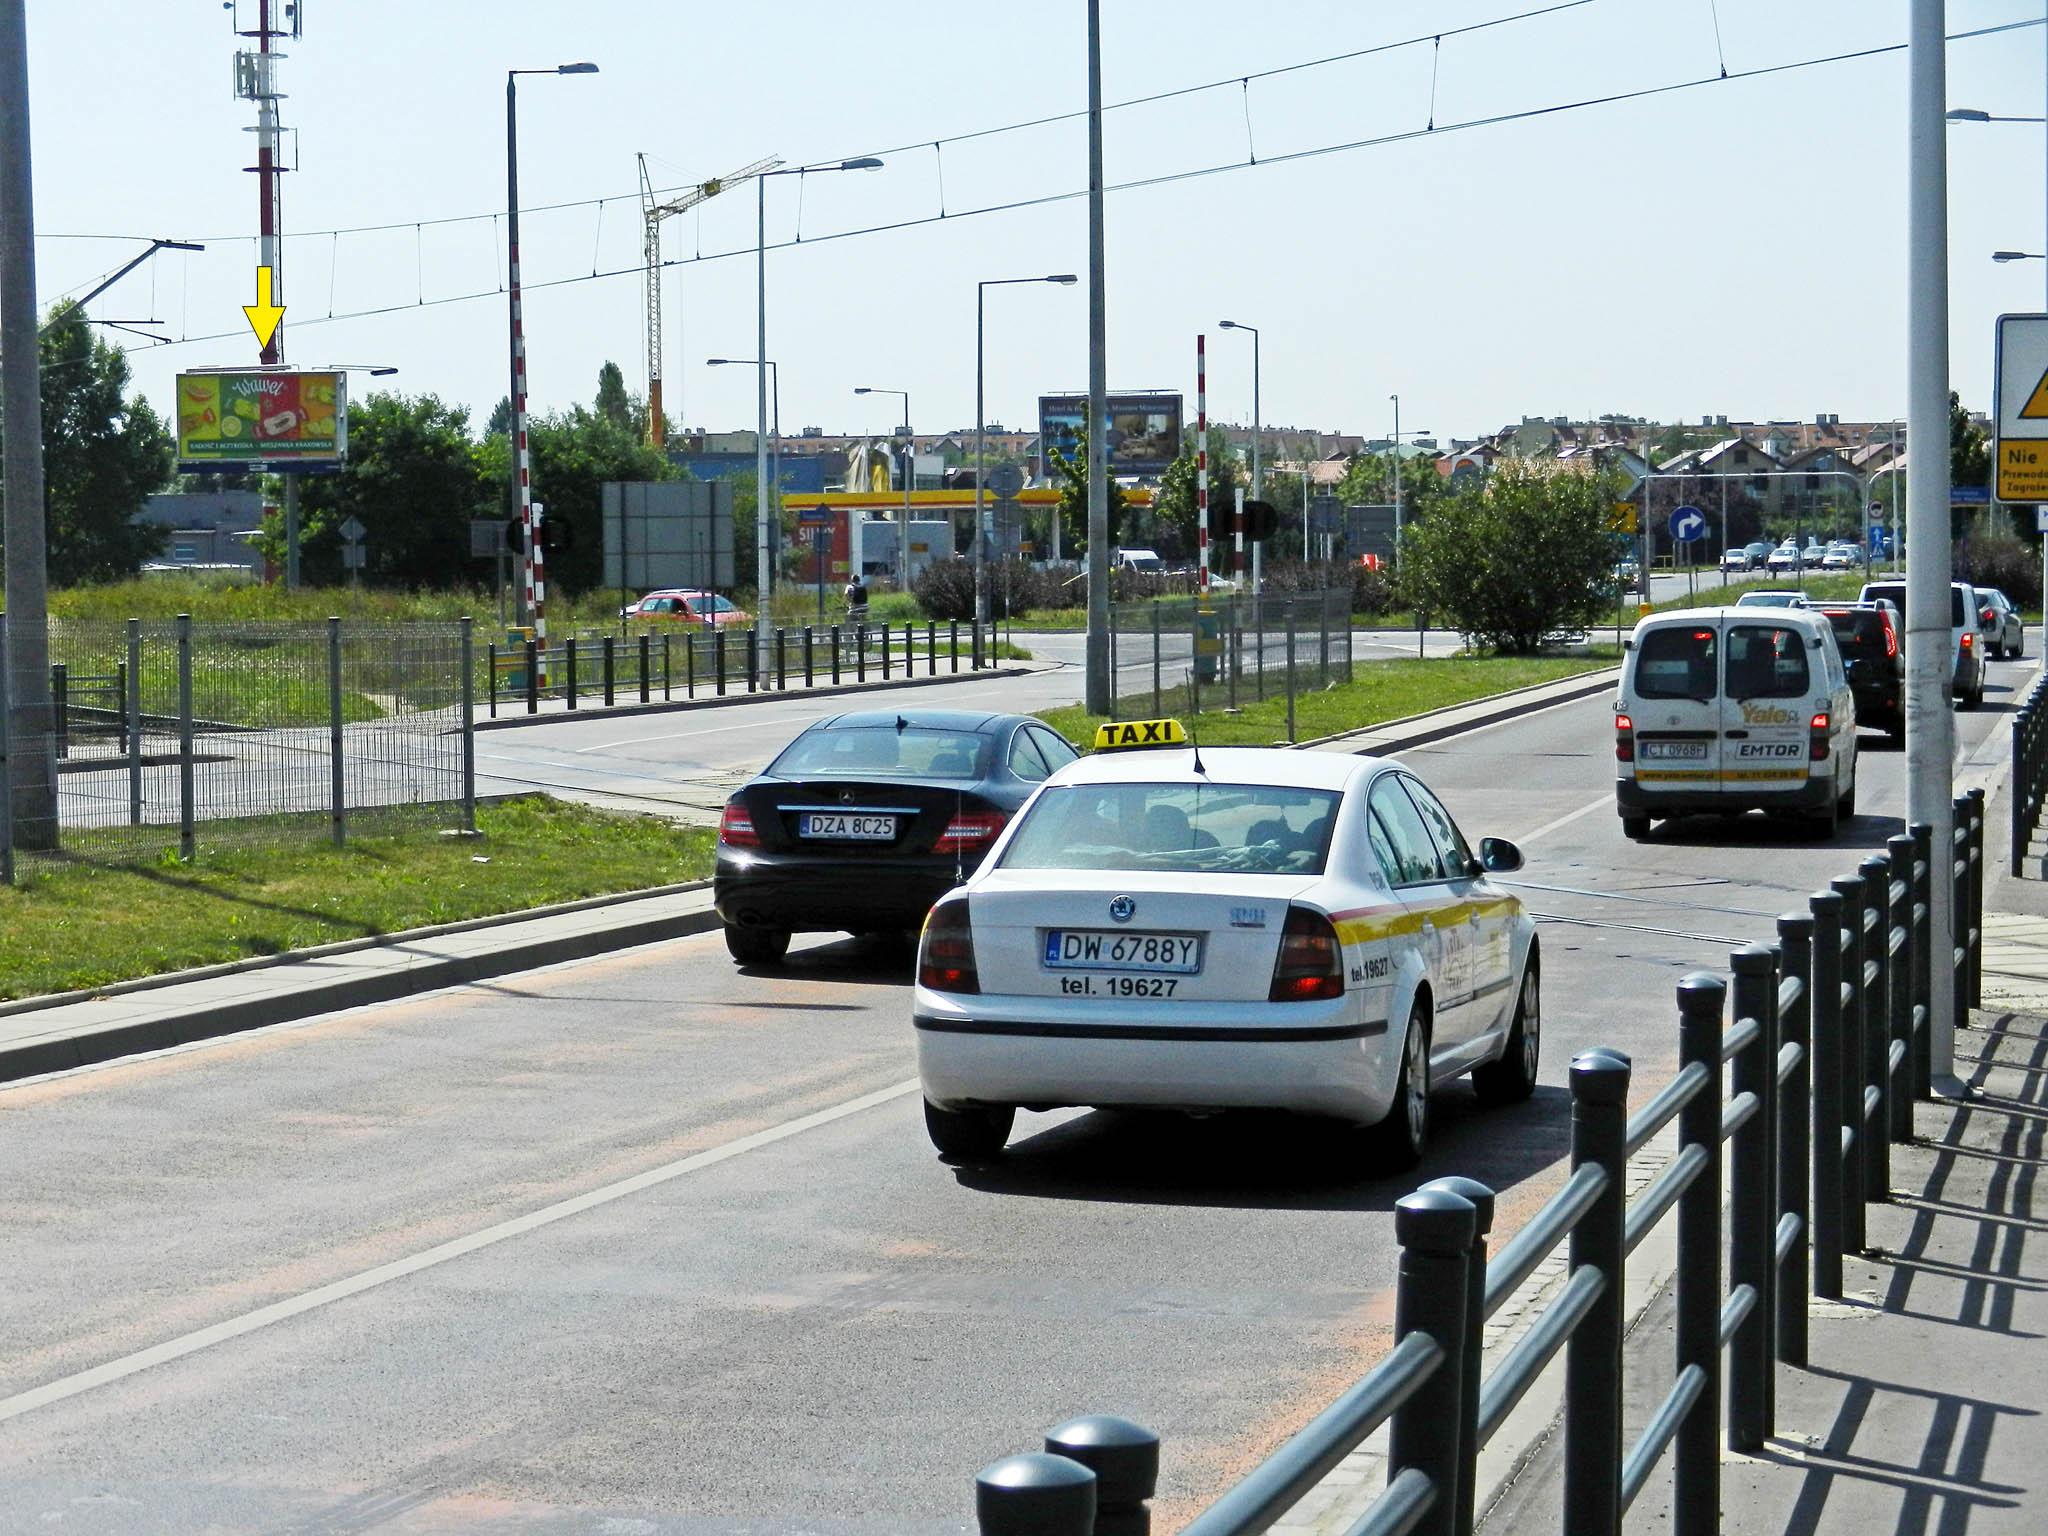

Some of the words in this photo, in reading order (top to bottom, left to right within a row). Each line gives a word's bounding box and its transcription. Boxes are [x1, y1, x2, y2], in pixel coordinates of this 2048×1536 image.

[232, 378, 284, 397] Wawel
[2008, 448, 2037, 464] Nie
[2008, 481, 2048, 494] Zagroże
[1743, 703, 1787, 723] Yale
[1102, 721, 1171, 745] TAXI
[1649, 744, 1664, 755] CT
[1740, 744, 1800, 756] EMTOR
[811, 817, 846, 833] DZA
[852, 818, 892, 834] 8C25
[1064, 935, 1102, 960] DW
[1111, 937, 1194, 964] 6788Y
[1061, 976, 1097, 995] tel.
[1106, 977, 1179, 997] 19627
